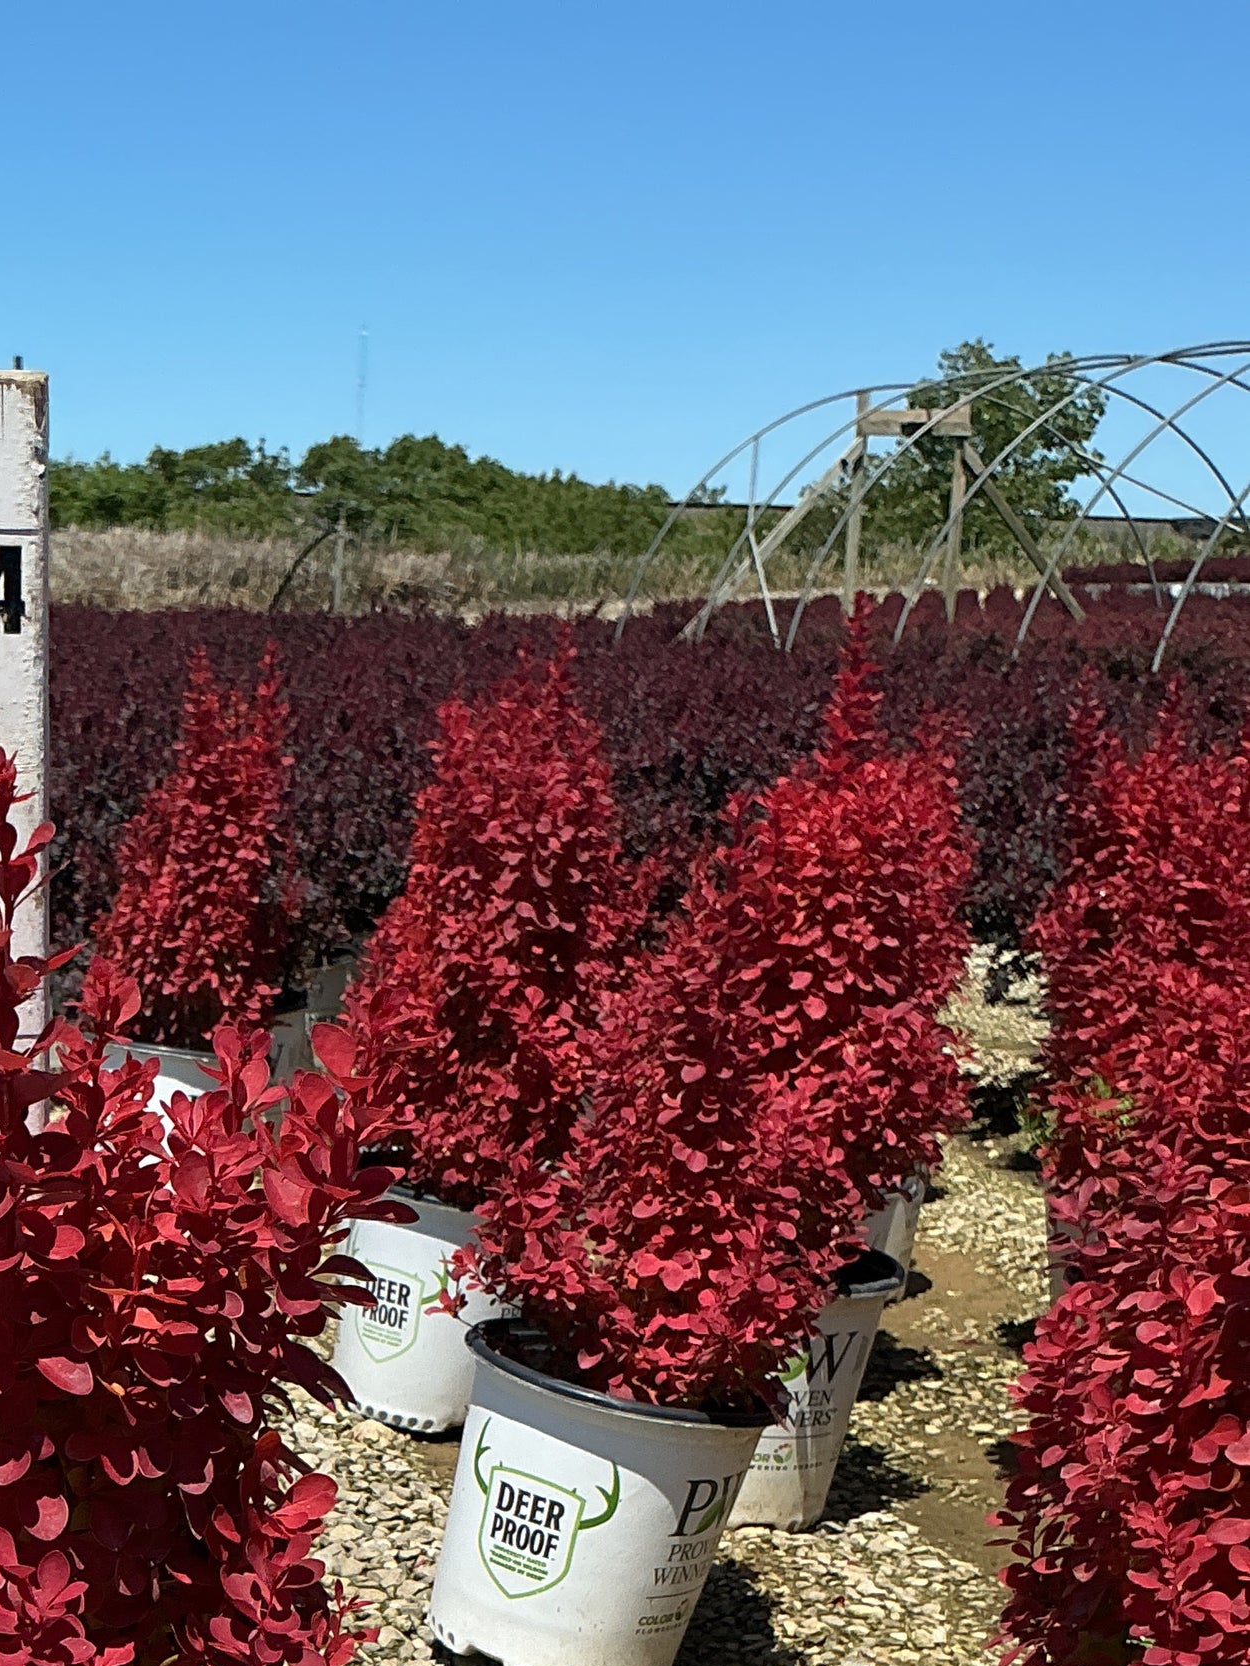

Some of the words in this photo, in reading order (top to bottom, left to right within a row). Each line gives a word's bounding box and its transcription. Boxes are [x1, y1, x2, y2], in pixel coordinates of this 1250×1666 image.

[792, 1390, 835, 1406] VEN
[496, 1480, 565, 1532] DEER
[490, 1512, 559, 1559] PROOF
